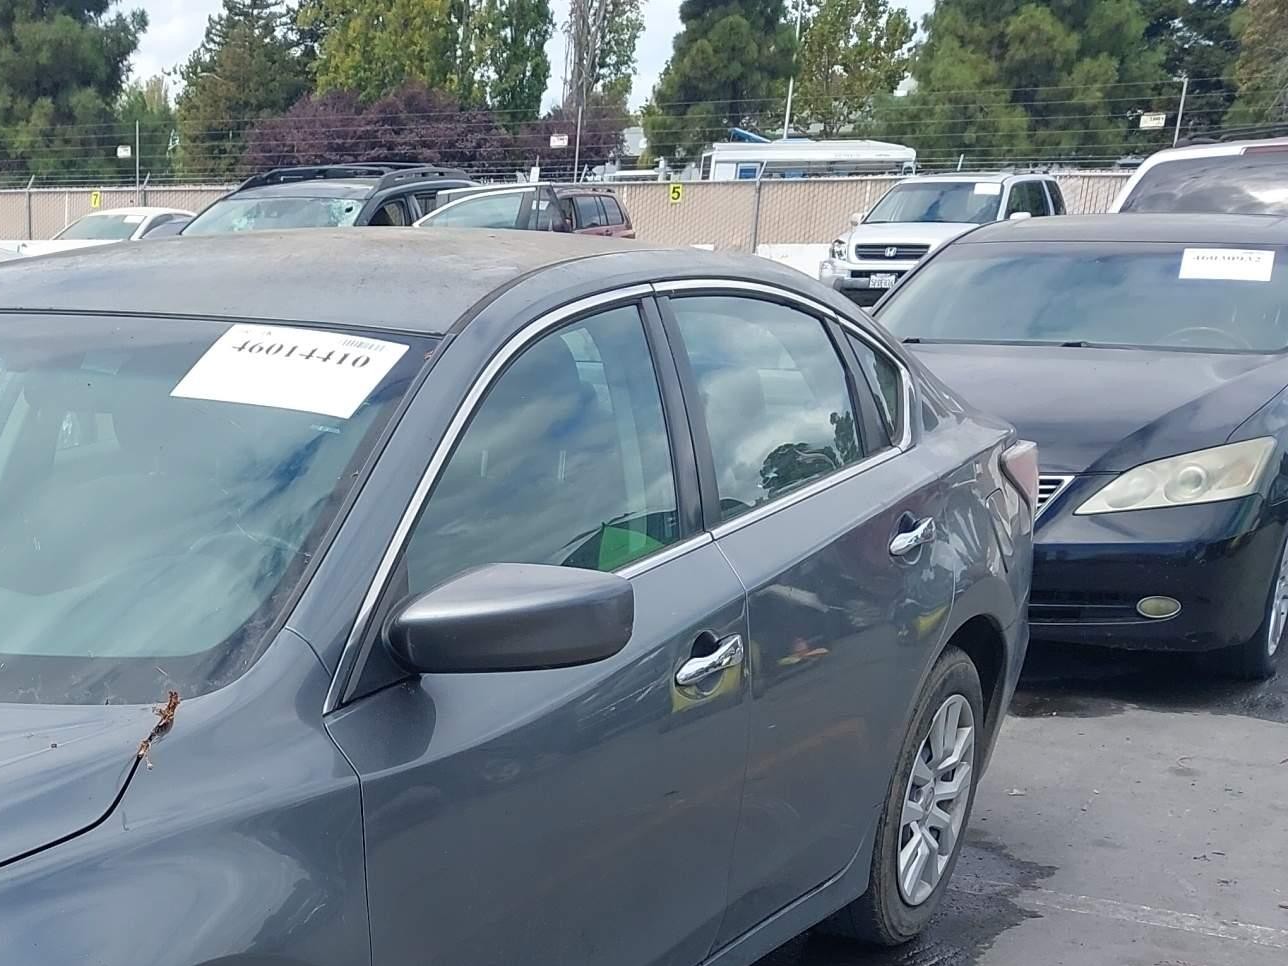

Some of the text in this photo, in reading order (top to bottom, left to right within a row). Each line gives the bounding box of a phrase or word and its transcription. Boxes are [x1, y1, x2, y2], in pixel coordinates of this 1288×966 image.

[92, 192, 99, 206] 7
[671, 185, 681, 201] 5
[232, 340, 371, 369] 46014410
